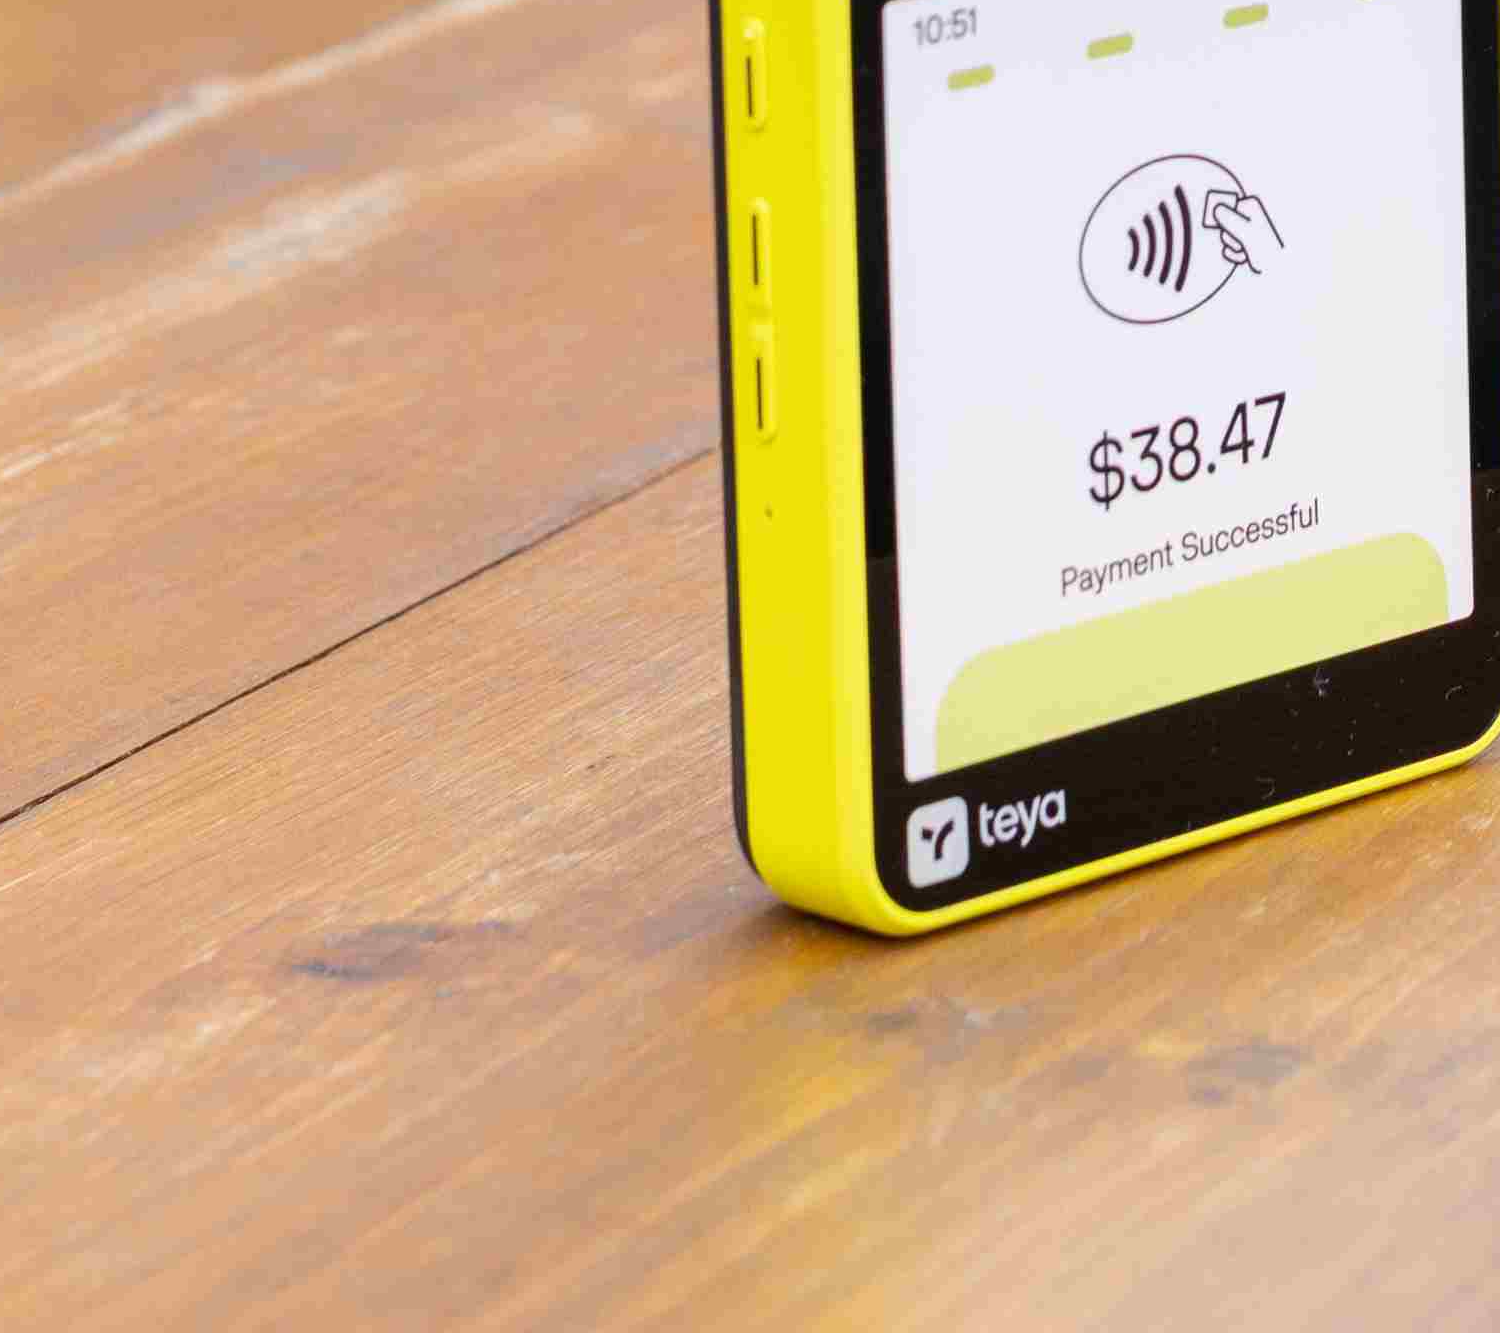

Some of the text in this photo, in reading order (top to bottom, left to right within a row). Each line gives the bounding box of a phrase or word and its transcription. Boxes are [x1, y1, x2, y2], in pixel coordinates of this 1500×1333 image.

[912, 7, 978, 49] 10:51
[1088, 390, 1287, 512] $38.47
[1060, 497, 1320, 597] Payment Successful
[978, 789, 1067, 848] teya
